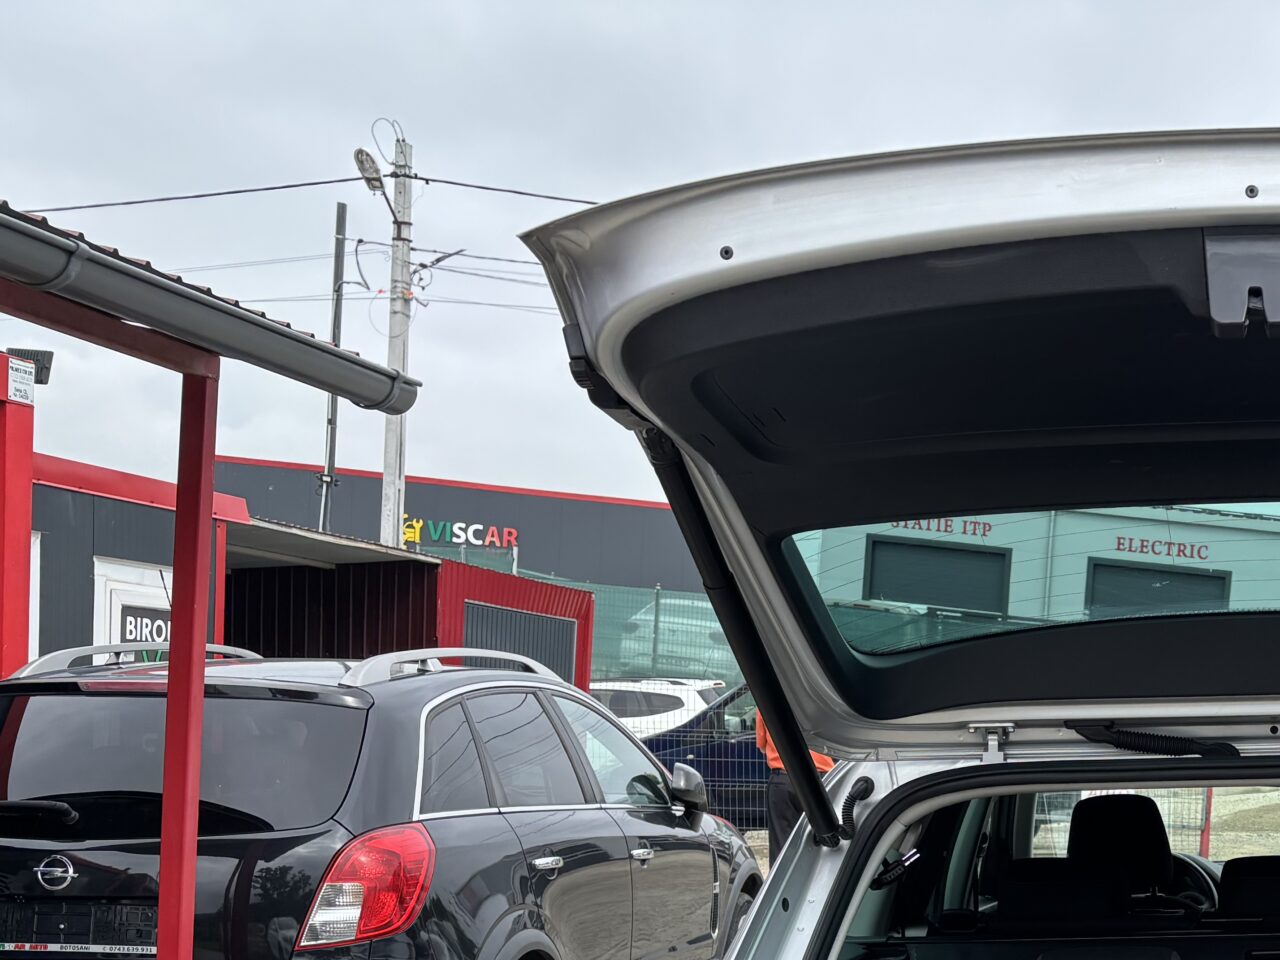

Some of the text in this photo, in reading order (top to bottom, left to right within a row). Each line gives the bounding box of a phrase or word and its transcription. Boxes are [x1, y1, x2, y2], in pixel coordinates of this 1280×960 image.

[427, 520, 518, 548] VISCAR
[961, 519, 992, 537] ITP
[1115, 536, 1209, 560] ELECTRIC
